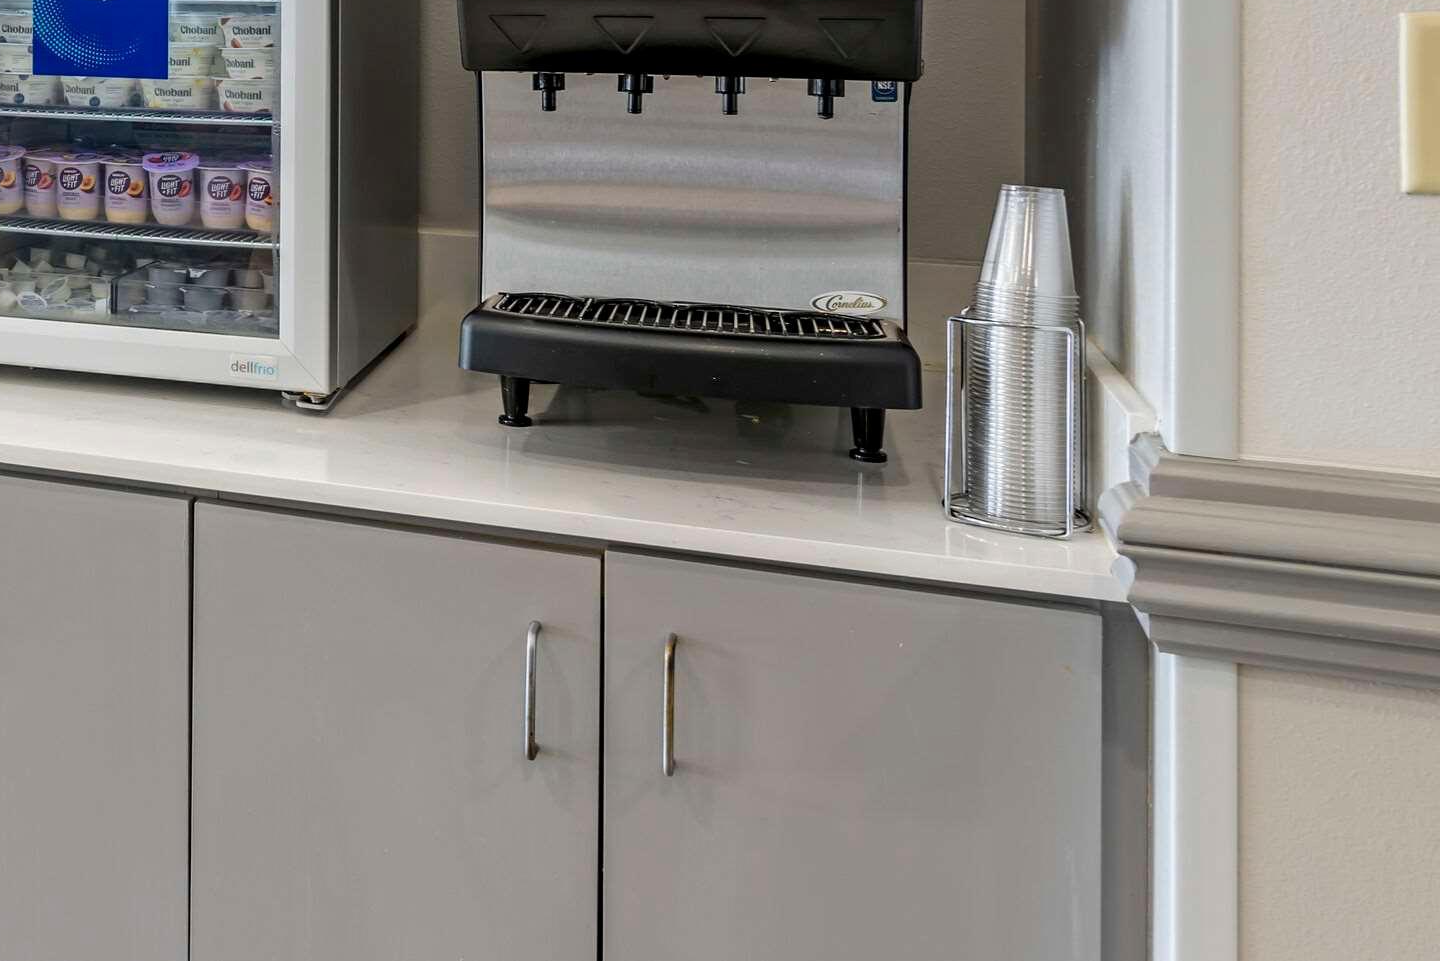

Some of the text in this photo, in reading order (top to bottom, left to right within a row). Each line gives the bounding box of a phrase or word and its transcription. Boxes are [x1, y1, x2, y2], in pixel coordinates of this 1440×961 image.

[232, 24, 272, 36] Chobani
[826, 294, 875, 312] Cornelius
[231, 359, 274, 376] dellfrio
